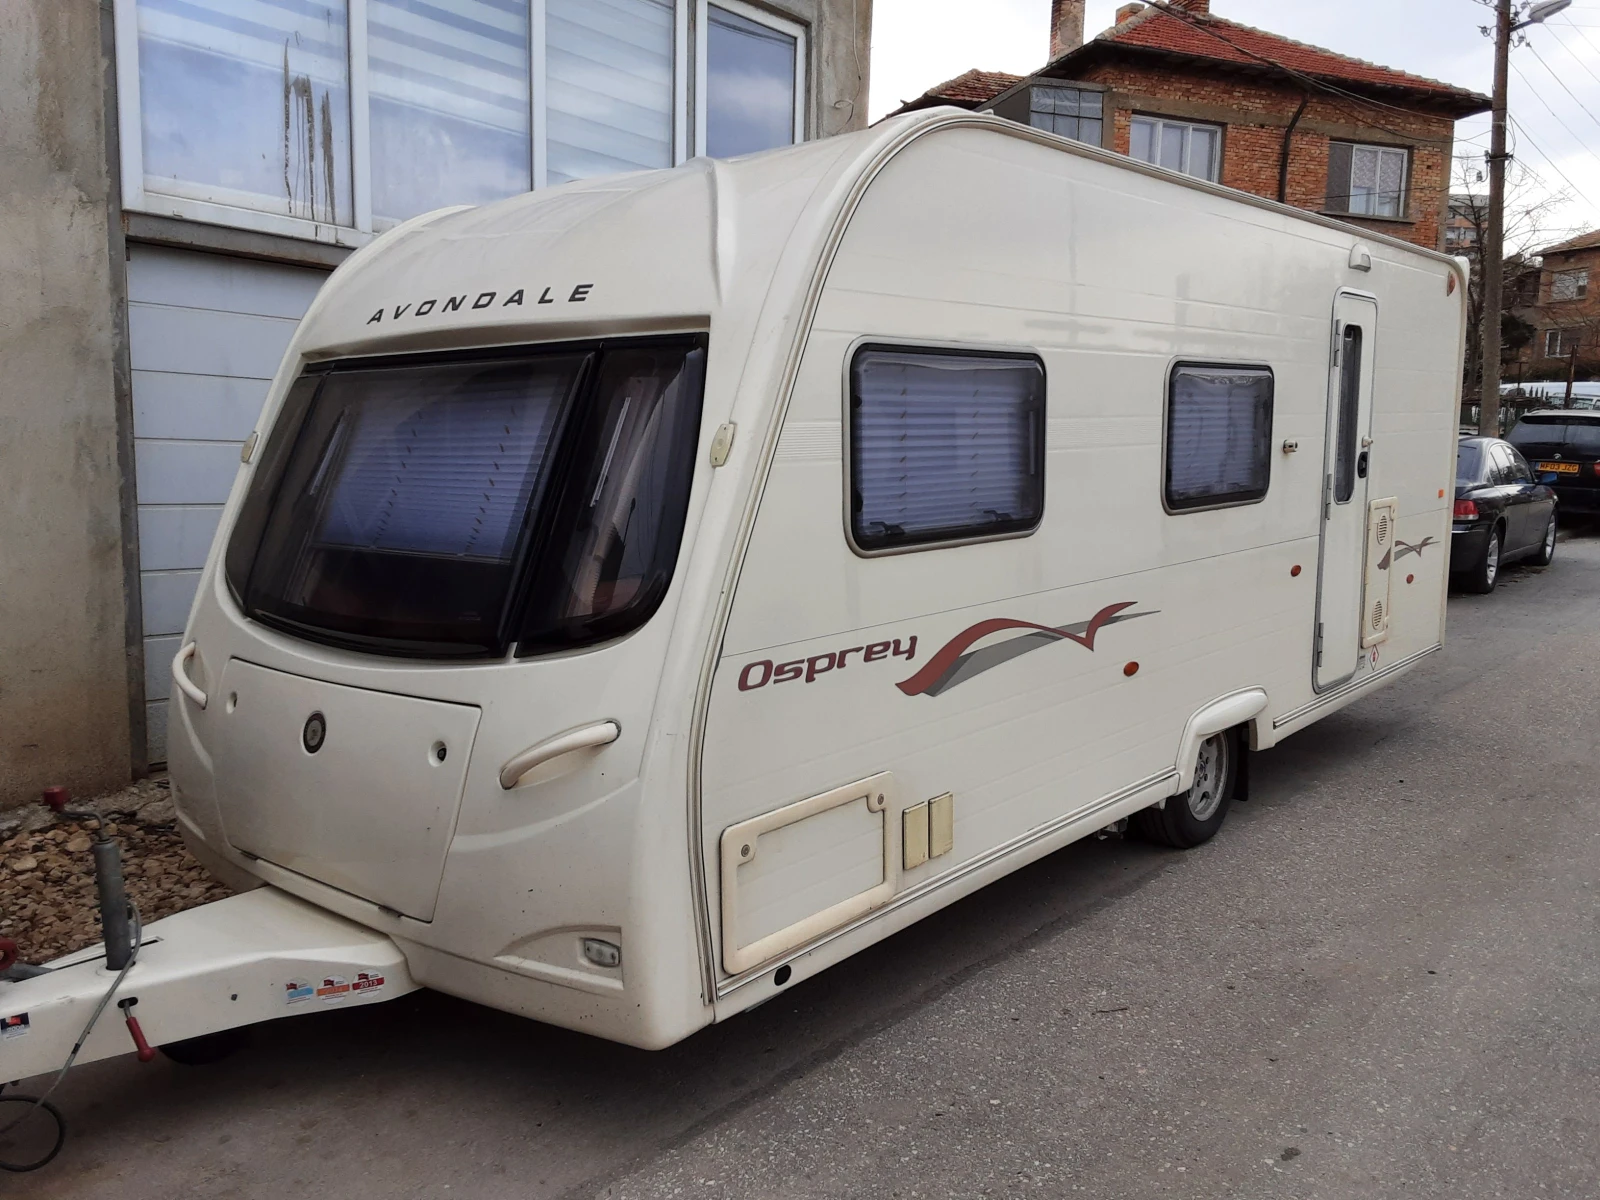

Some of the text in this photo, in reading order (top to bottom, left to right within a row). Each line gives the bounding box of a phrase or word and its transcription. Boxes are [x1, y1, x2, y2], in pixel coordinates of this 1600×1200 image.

[366, 284, 594, 325] AVONDALE
[738, 635, 918, 692] Osprey
[359, 979, 378, 989] 2013
